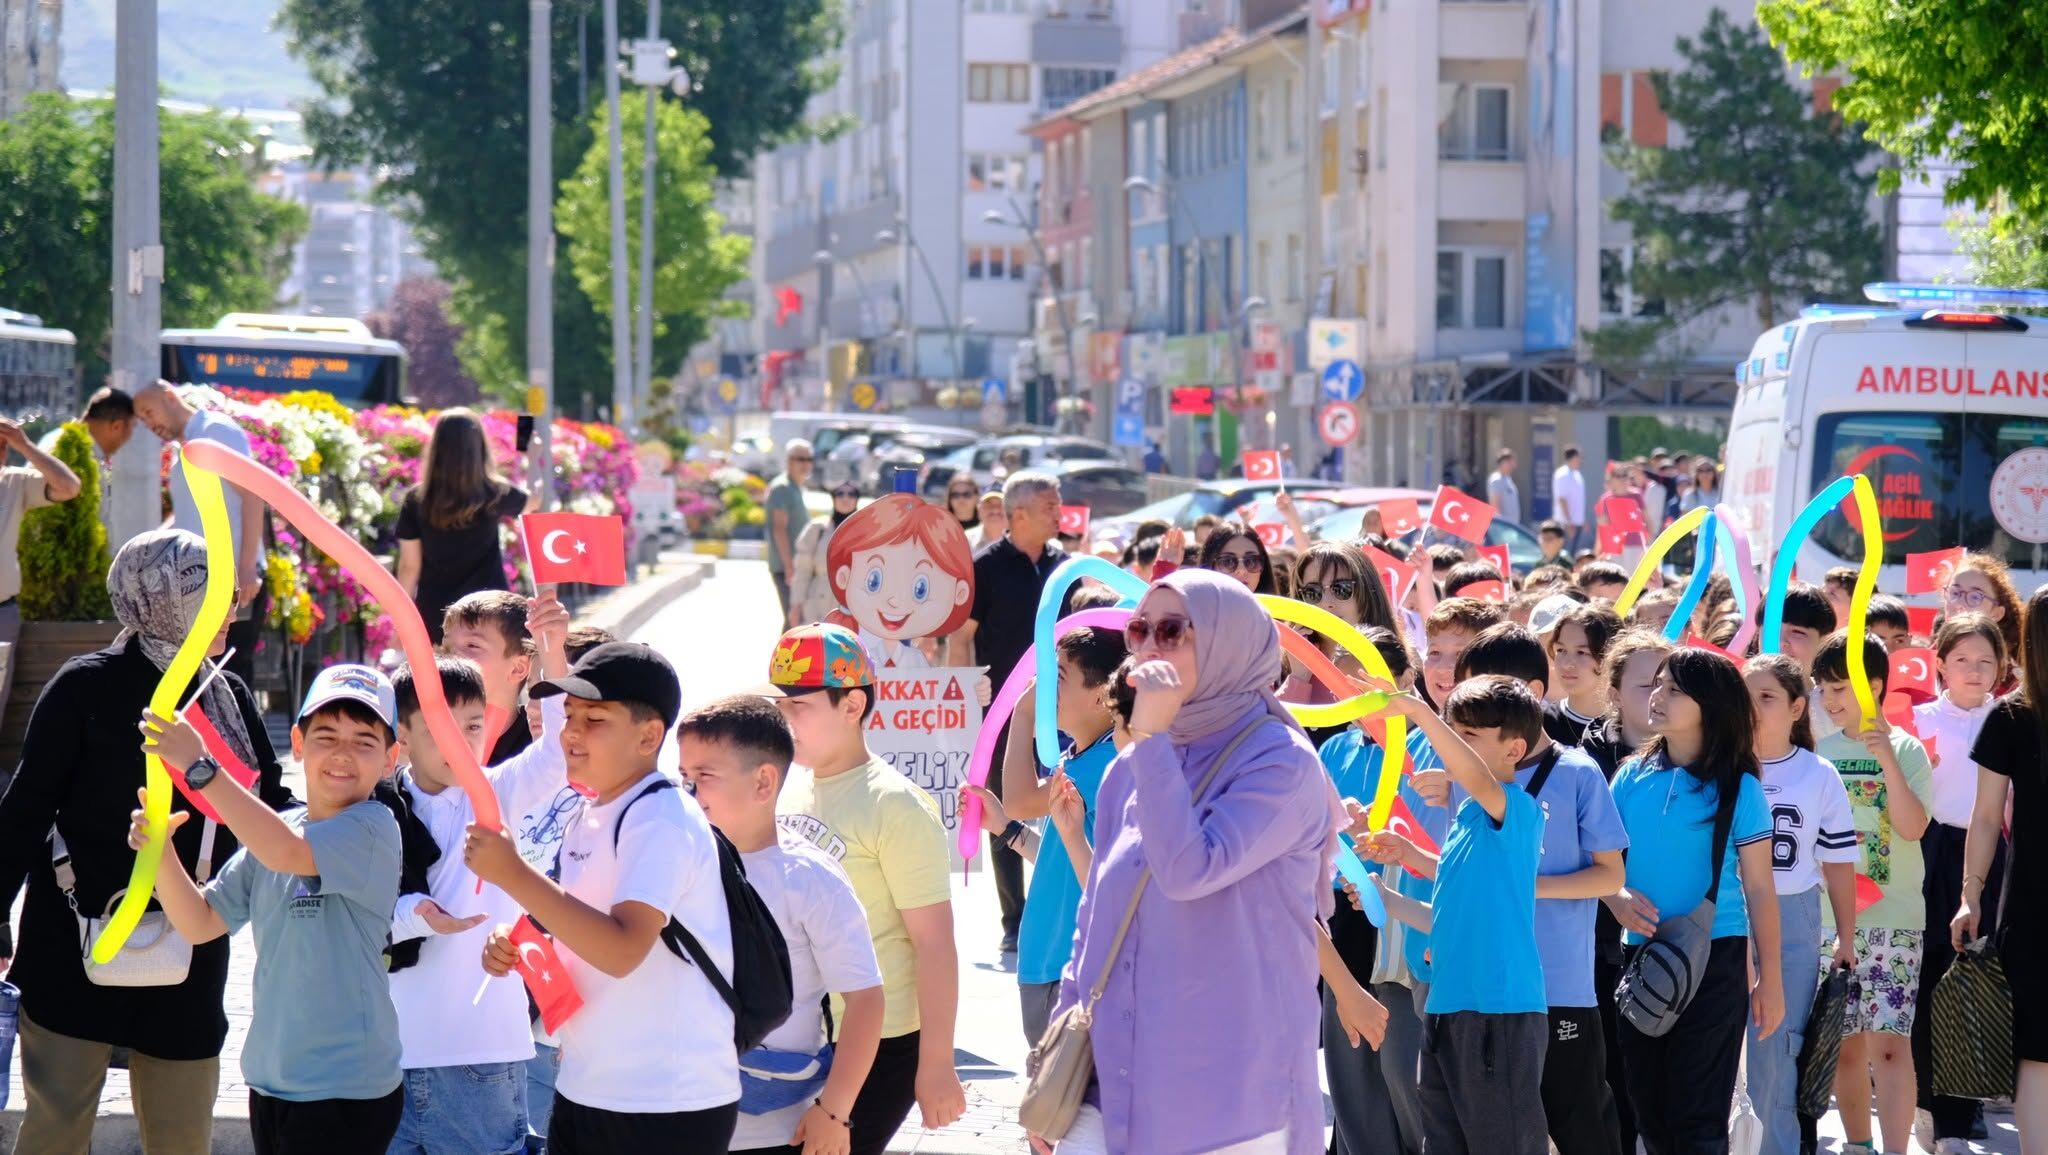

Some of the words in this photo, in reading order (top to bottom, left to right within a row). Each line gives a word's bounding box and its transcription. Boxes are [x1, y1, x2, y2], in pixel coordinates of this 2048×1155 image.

[1877, 496, 1935, 518] AĞLIK
[873, 676, 939, 700] İKKAT
[893, 703, 966, 735] GEÇİDİ
